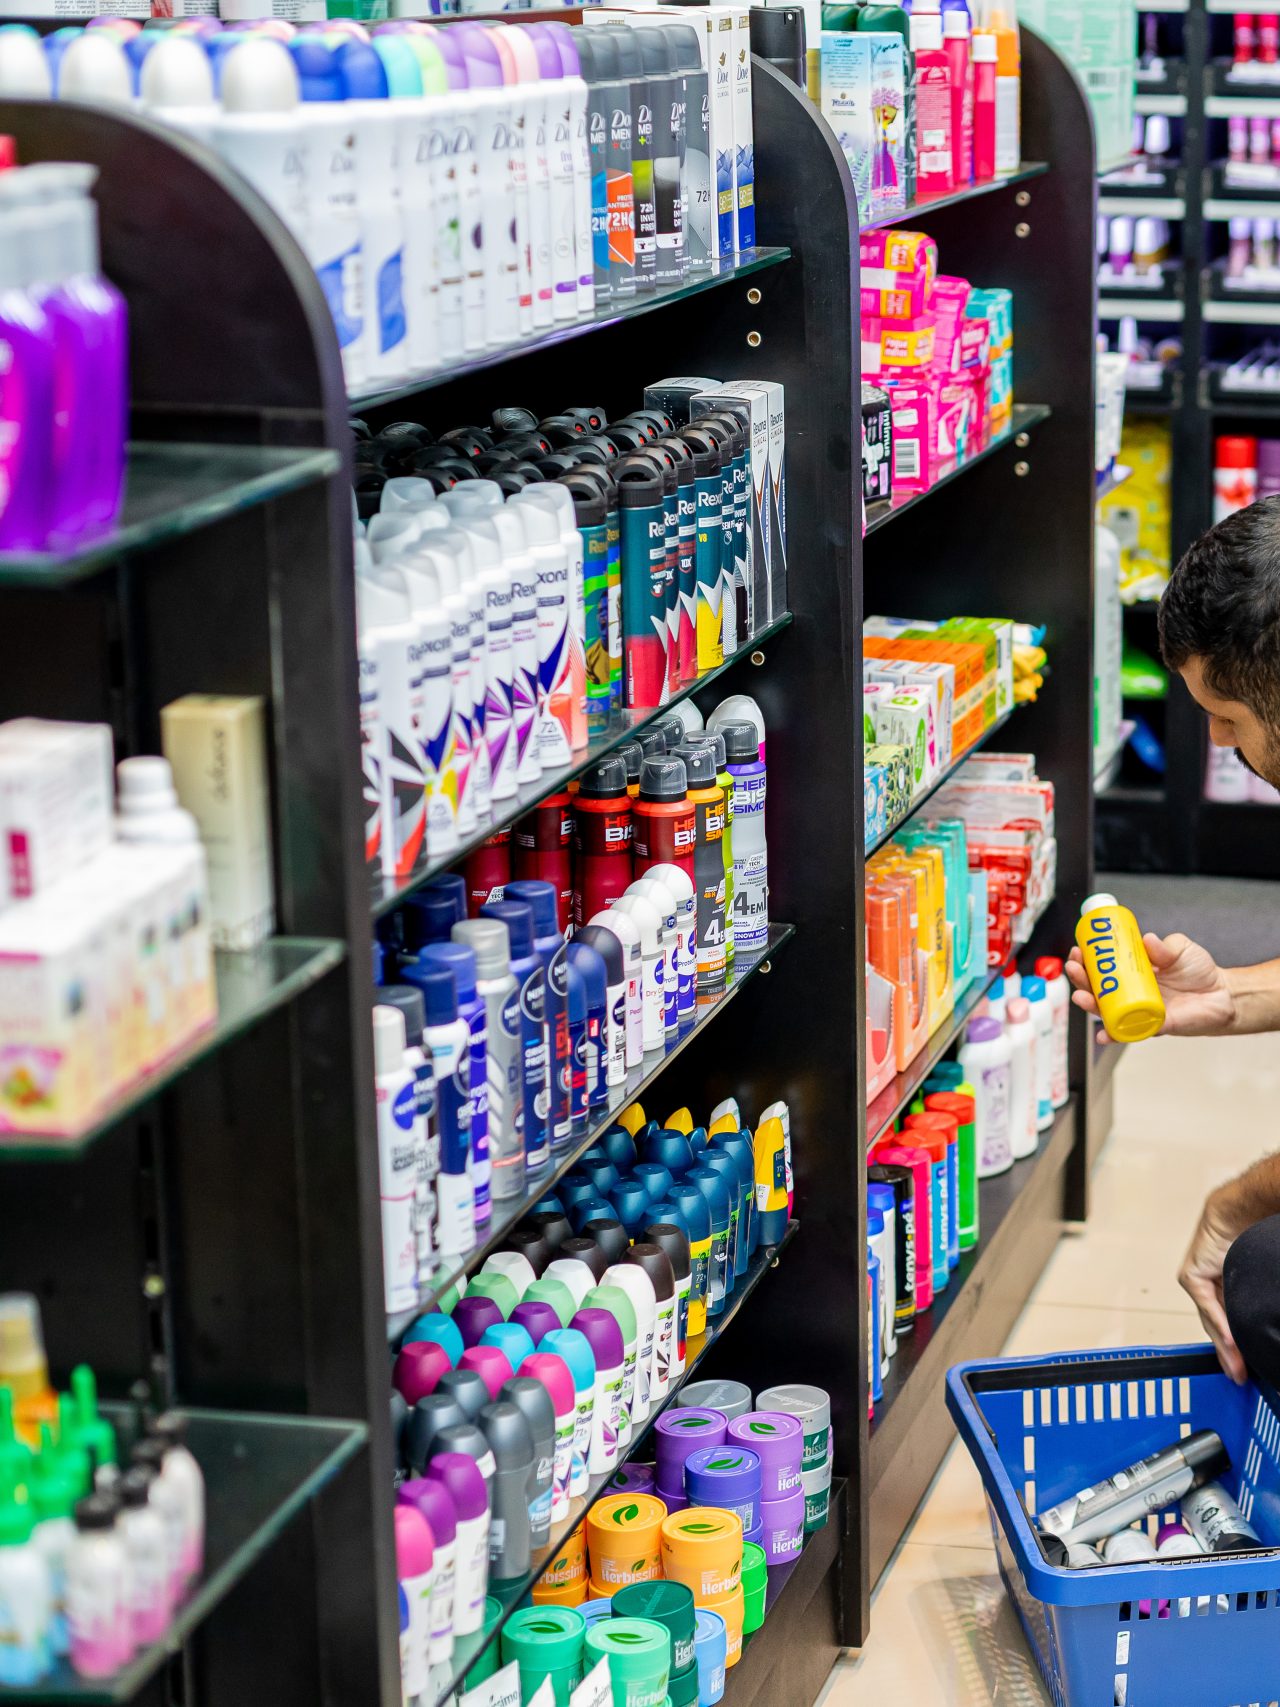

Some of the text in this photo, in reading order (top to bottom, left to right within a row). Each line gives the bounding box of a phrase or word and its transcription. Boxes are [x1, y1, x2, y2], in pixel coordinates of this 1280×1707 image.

[770, 412, 783, 425] Rexona
[753, 420, 766, 436] Rexona
[882, 410, 891, 457] Intimus
[698, 492, 722, 507] Rexo
[679, 500, 696, 515] Rex
[698, 533, 708, 542] V8
[605, 815, 631, 828] HE
[704, 919, 719, 944] 4
[1086, 917, 1119, 999] barla
[602, 1567, 660, 1583] Herbissim
